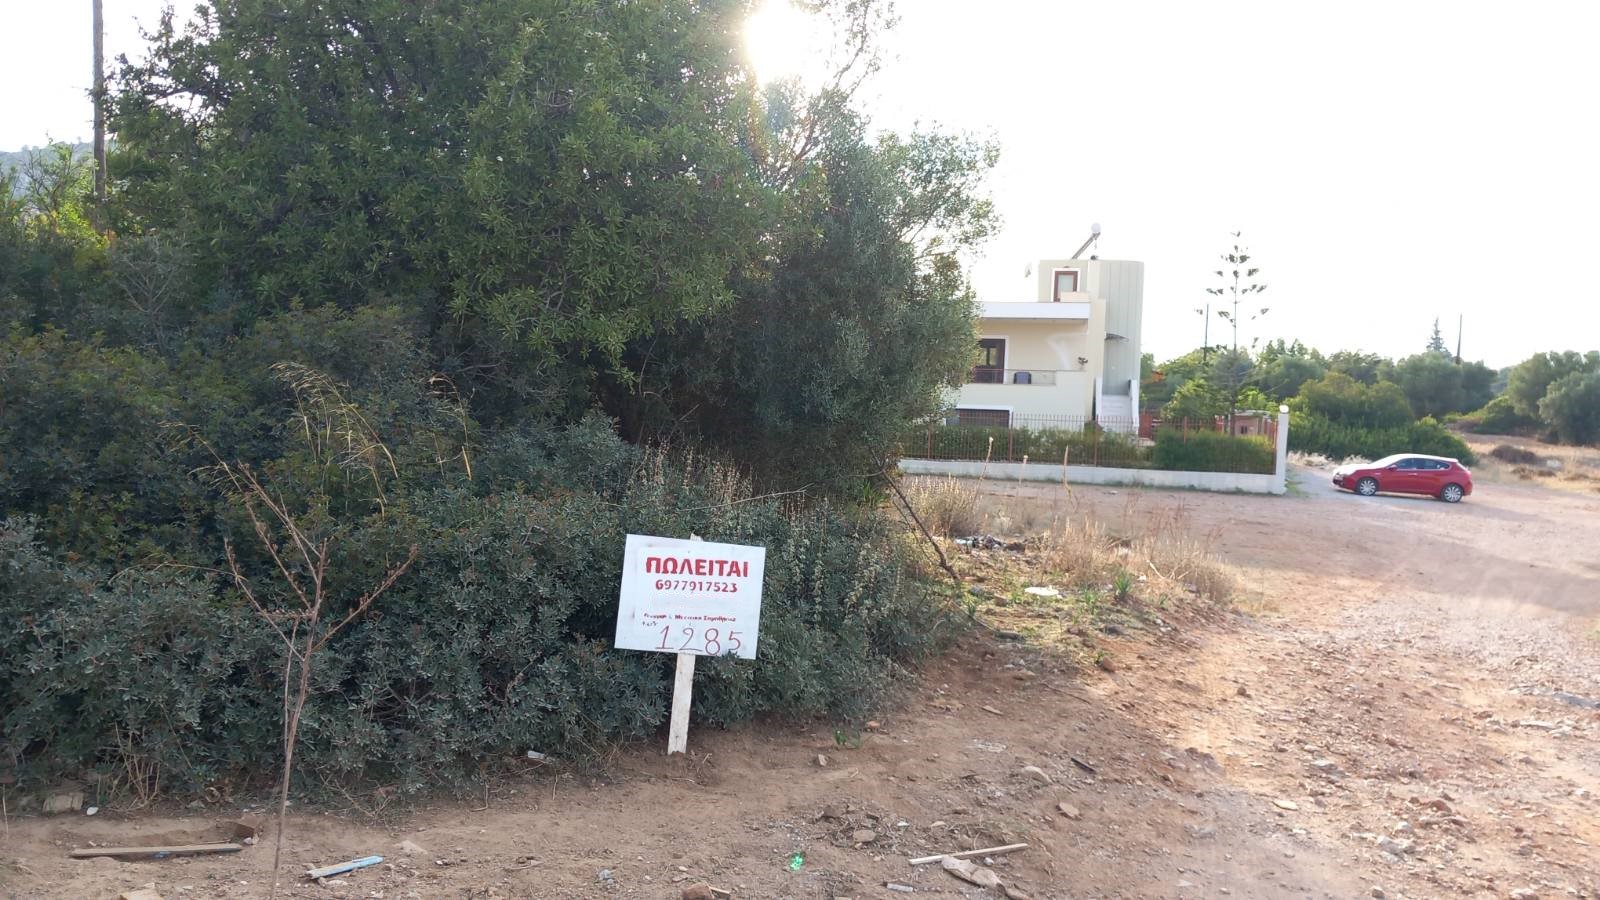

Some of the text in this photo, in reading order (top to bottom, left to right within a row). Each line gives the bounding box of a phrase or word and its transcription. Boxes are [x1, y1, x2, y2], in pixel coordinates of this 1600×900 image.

[645, 557, 749, 577] ΠΩΛΕΙΤΑΙ
[655, 579, 738, 592] 6977917523
[655, 625, 743, 655] 1285
